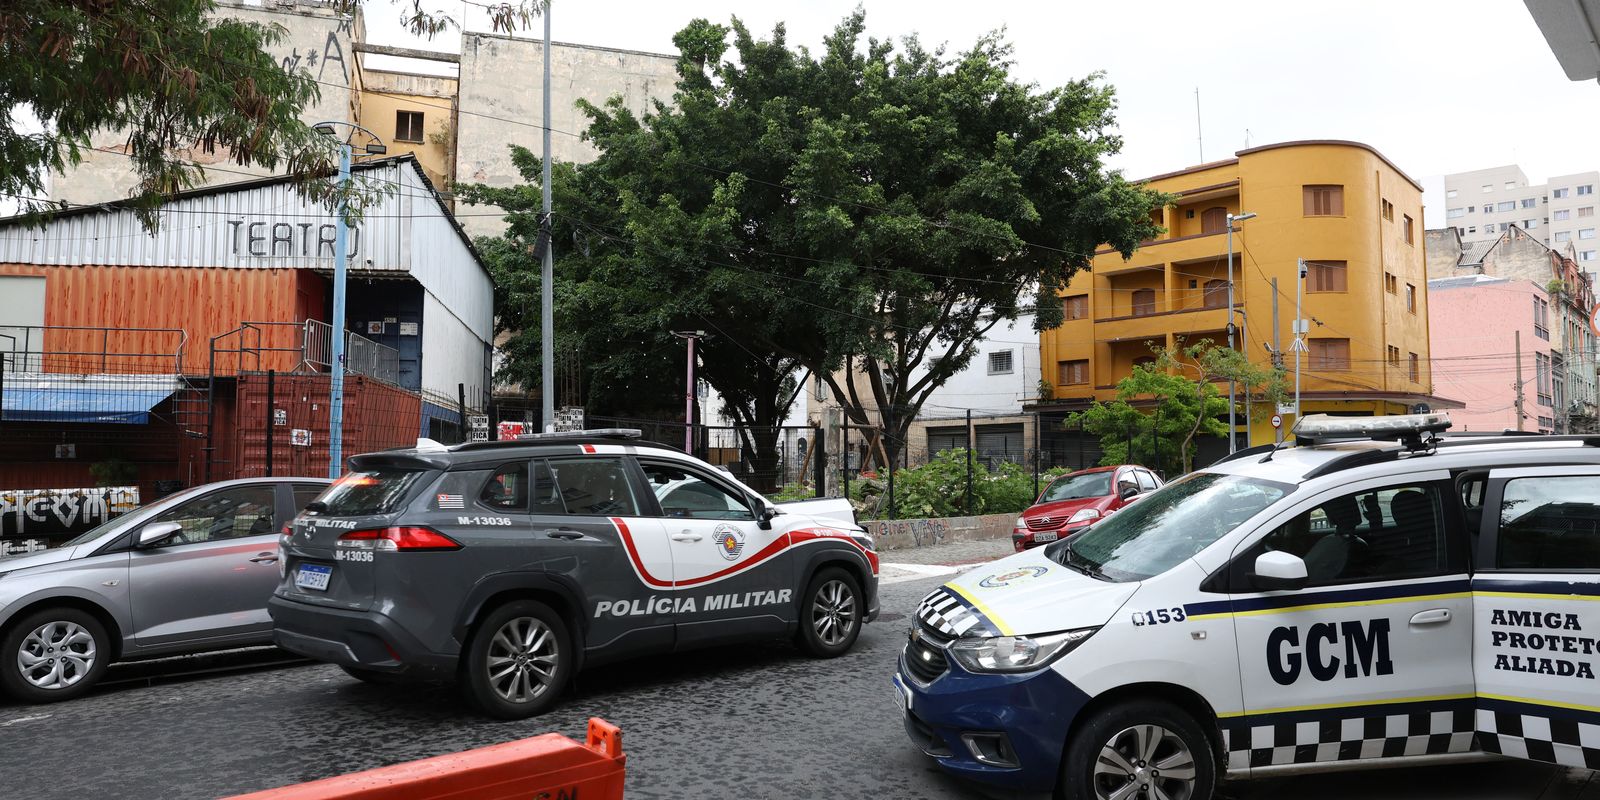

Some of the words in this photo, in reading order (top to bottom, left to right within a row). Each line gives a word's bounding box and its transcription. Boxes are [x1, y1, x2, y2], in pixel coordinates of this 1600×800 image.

[315, 518, 358, 530] MILITAR
[458, 516, 512, 526] M-13036
[335, 550, 373, 562] M-13036
[594, 595, 697, 618] POLÍCIA
[703, 588, 793, 611] MILITAR
[1145, 607, 1186, 626] 153
[1491, 609, 1582, 631] AMIGA
[1266, 618, 1394, 685] GCM
[1494, 653, 1595, 679] ALIADA
